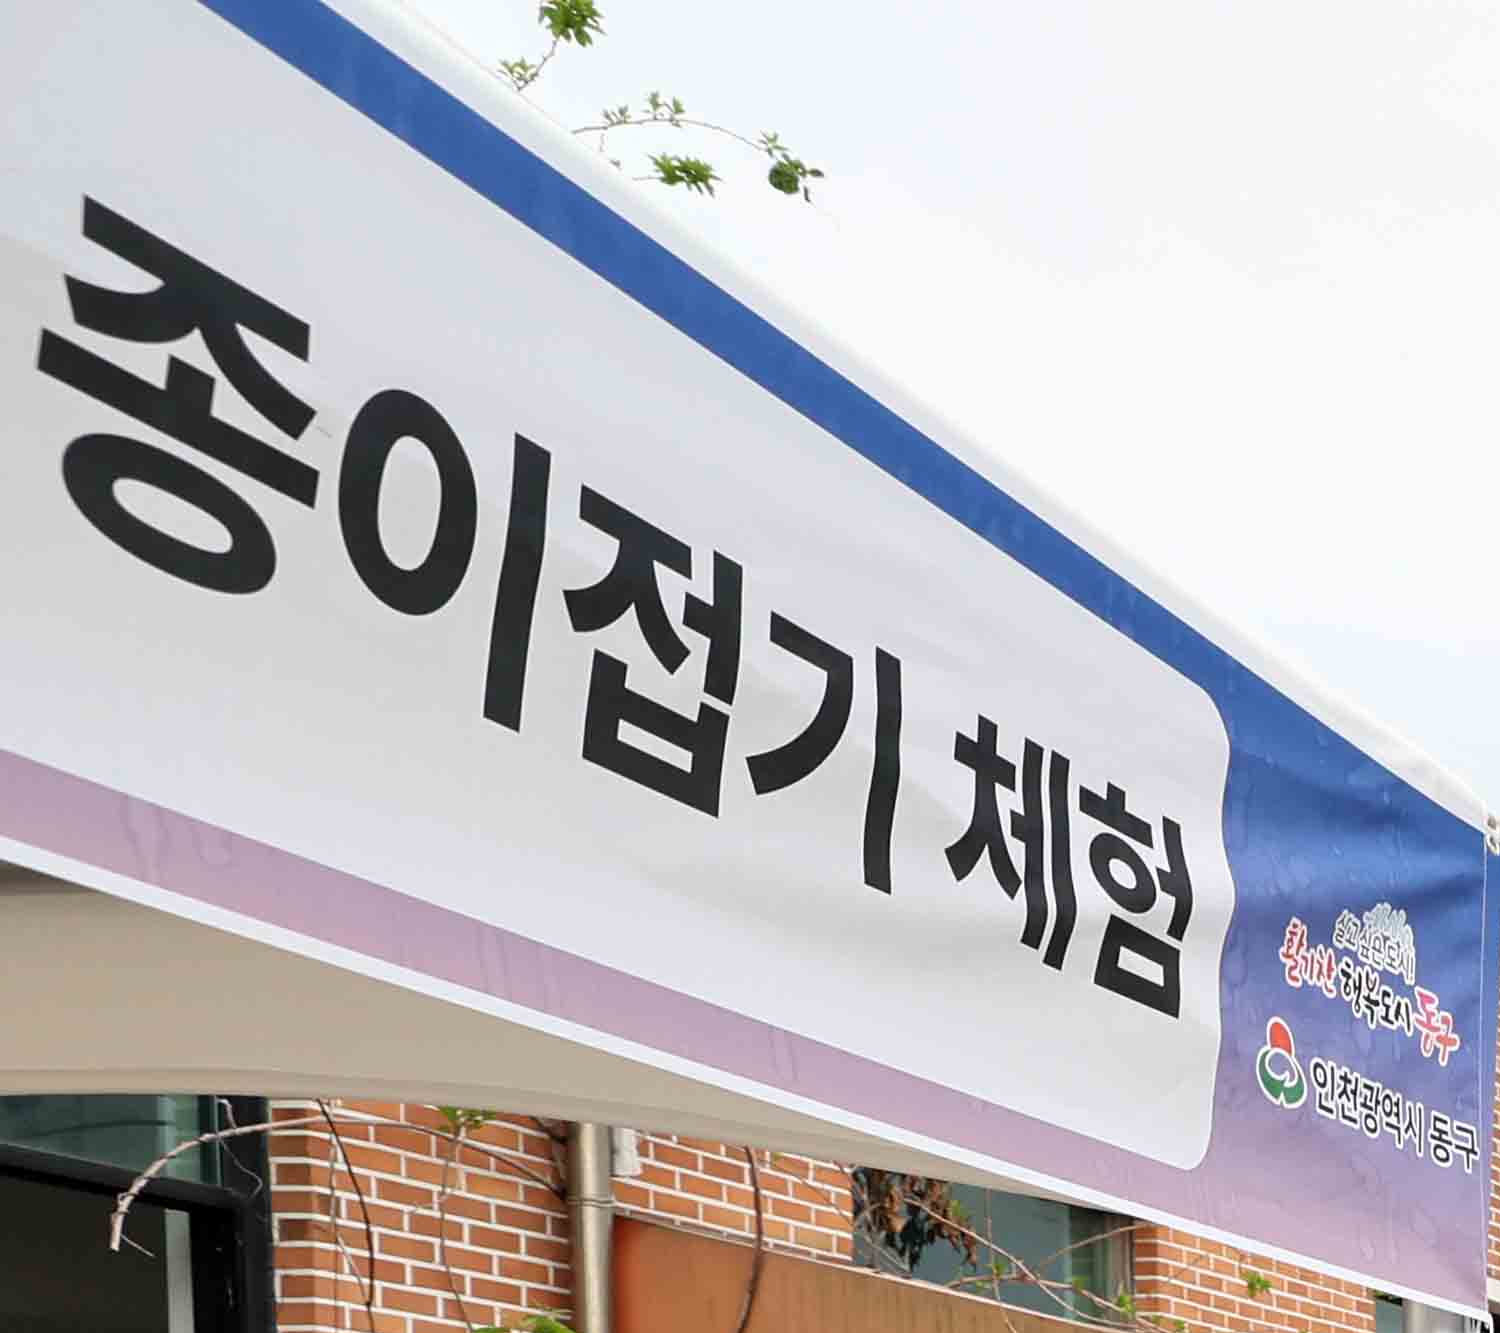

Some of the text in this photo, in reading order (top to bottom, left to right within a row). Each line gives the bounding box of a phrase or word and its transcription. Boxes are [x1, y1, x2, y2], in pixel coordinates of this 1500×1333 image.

[36, 193, 1194, 1019] 종이접기 체험
[1281, 917, 1460, 1064] 활기찬 행복도시 동구
[1312, 1060, 1478, 1171] 인천광역시 동구
